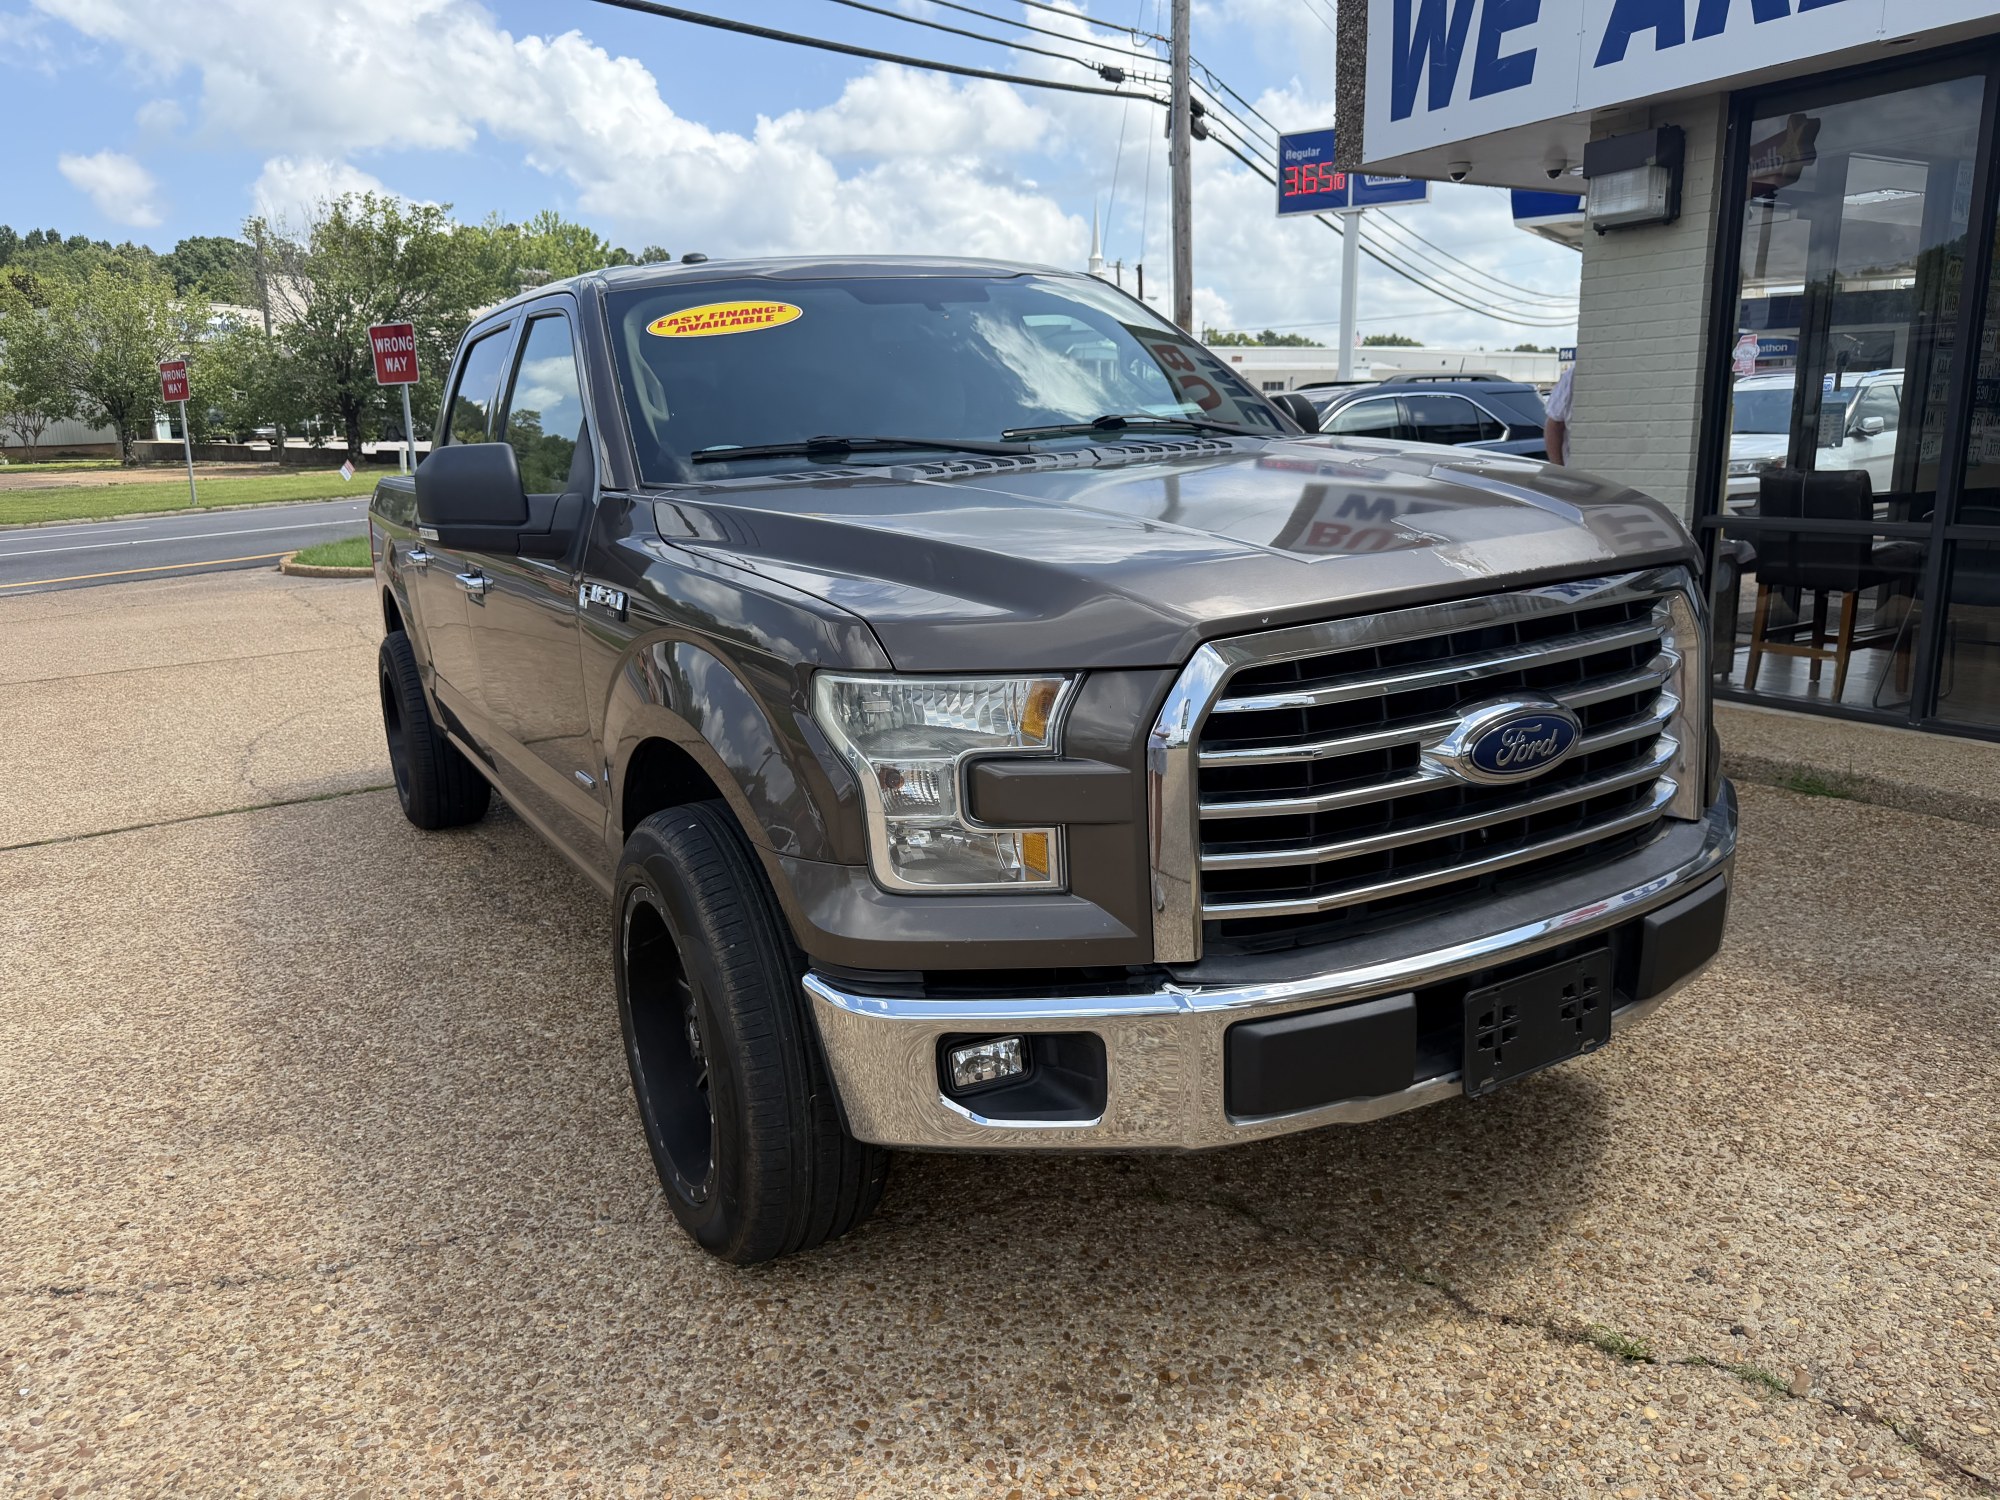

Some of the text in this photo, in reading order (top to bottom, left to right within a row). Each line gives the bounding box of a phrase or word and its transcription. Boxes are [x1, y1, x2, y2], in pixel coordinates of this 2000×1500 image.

[1390, 0, 1540, 122] WE
[1285, 147, 1321, 160] Regular
[657, 305, 787, 329] EASY FINANCE
[675, 314, 775, 334] AVAILABLE
[375, 335, 413, 353] WRONG
[385, 356, 407, 373] WAY
[162, 369, 186, 381] WRONG
[167, 383, 182, 394] WAY
[1495, 723, 1558, 767] Ford
